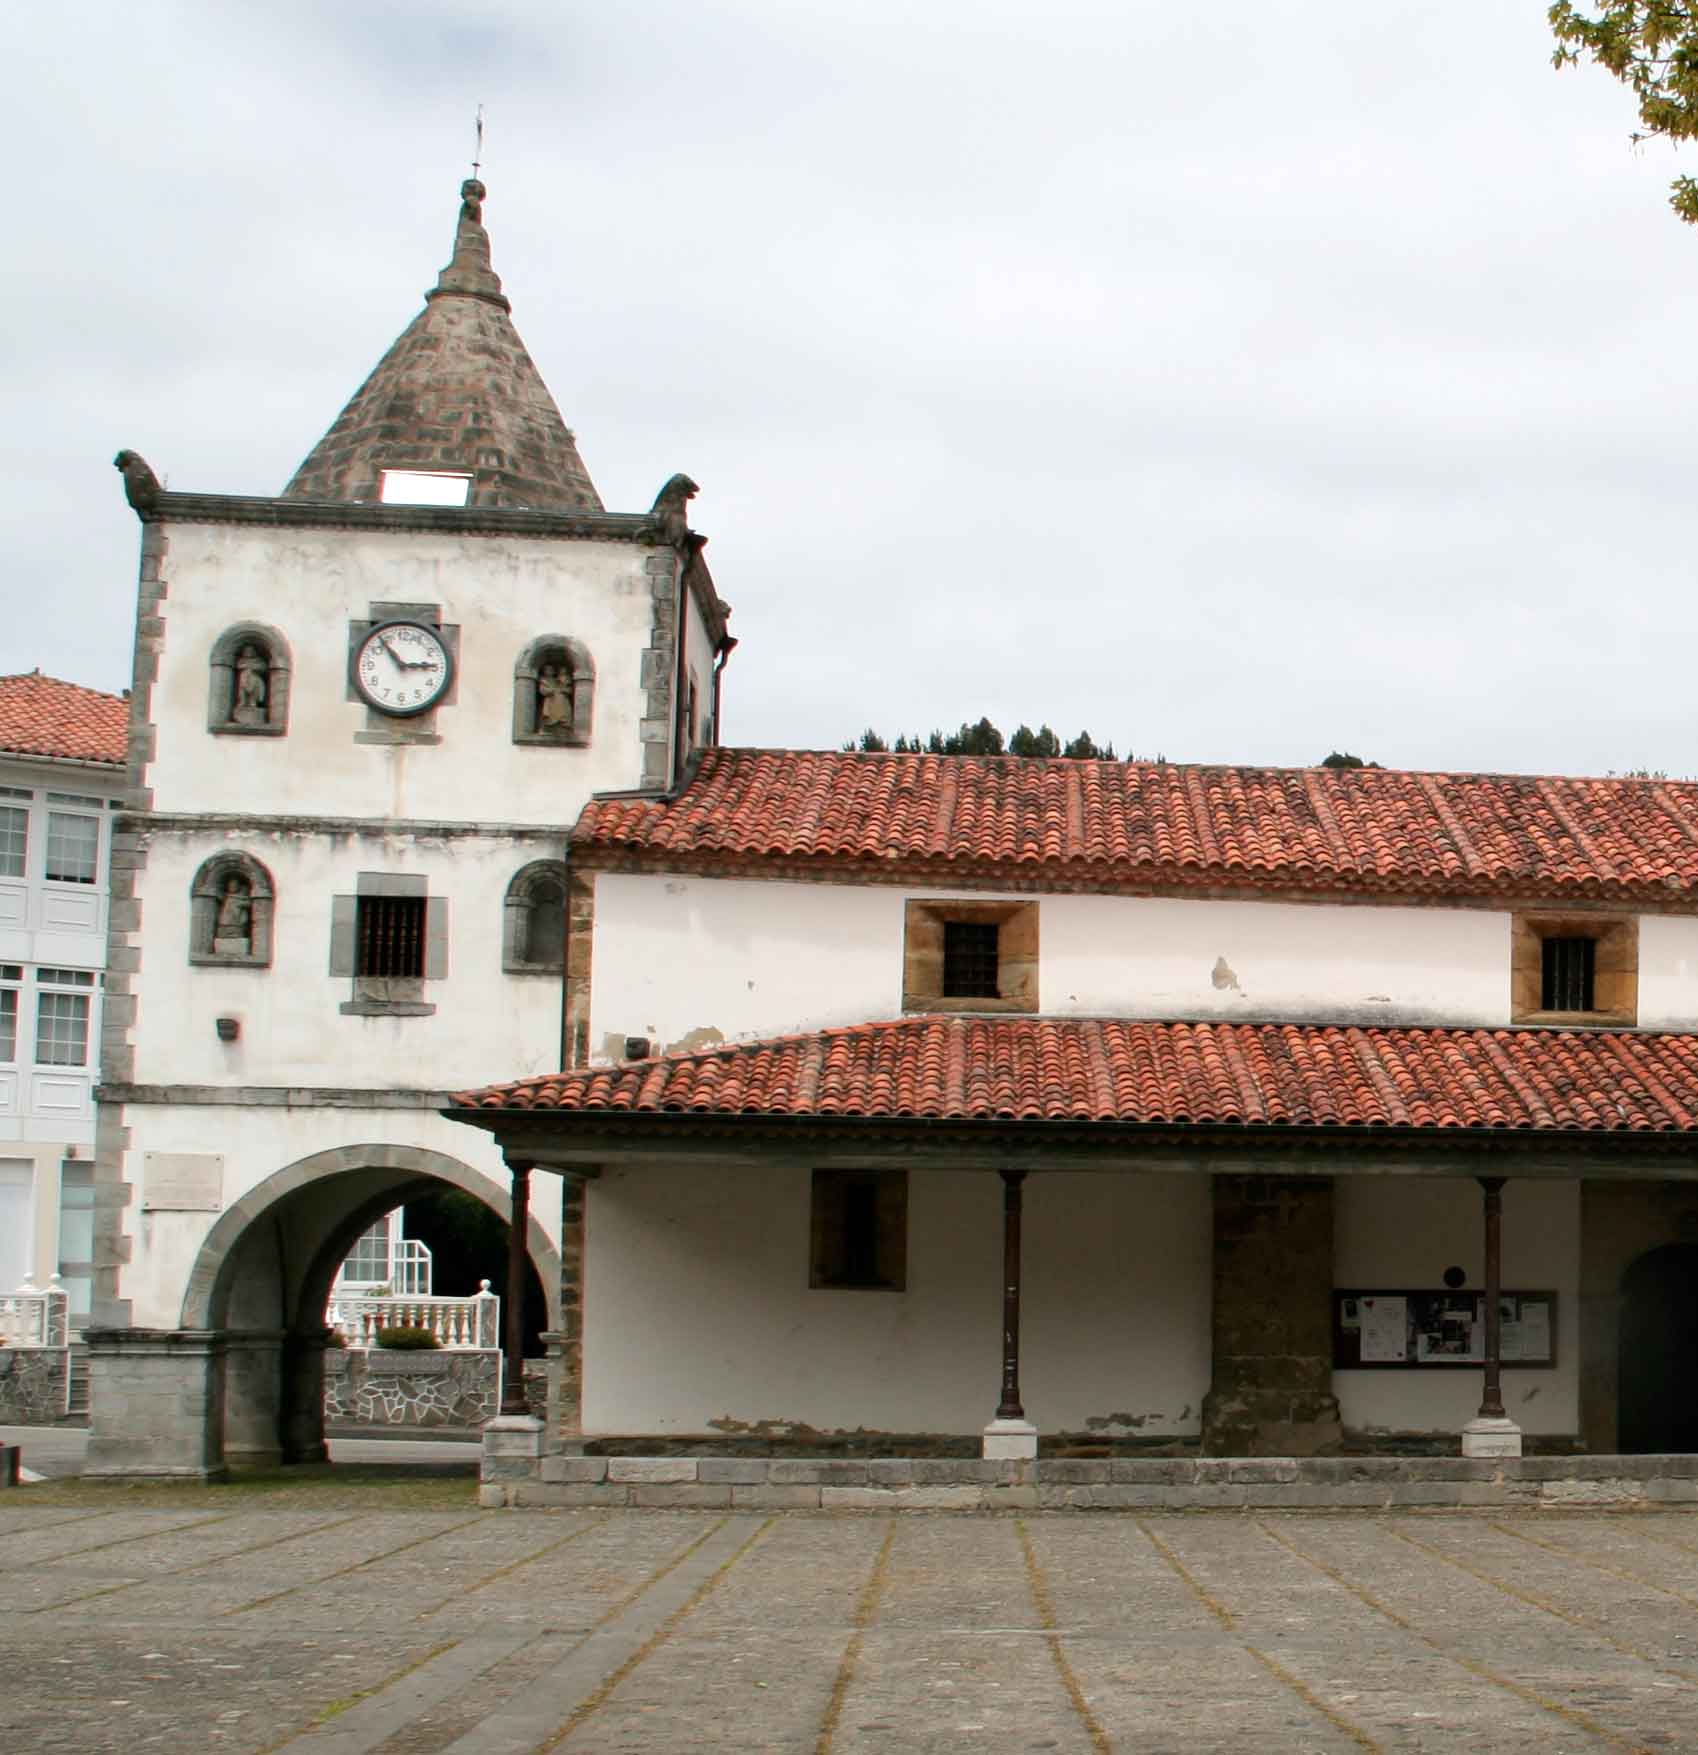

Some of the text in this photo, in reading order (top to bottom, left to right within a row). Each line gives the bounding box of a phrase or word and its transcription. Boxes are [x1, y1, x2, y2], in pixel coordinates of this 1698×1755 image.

[427, 647, 435, 657] 2
[367, 661, 375, 671] 9
[370, 676, 378, 686] 8
[425, 678, 433, 686] 4
[383, 688, 391, 698] 7
[397, 691, 406, 702] 6
[415, 688, 422, 698] 5
